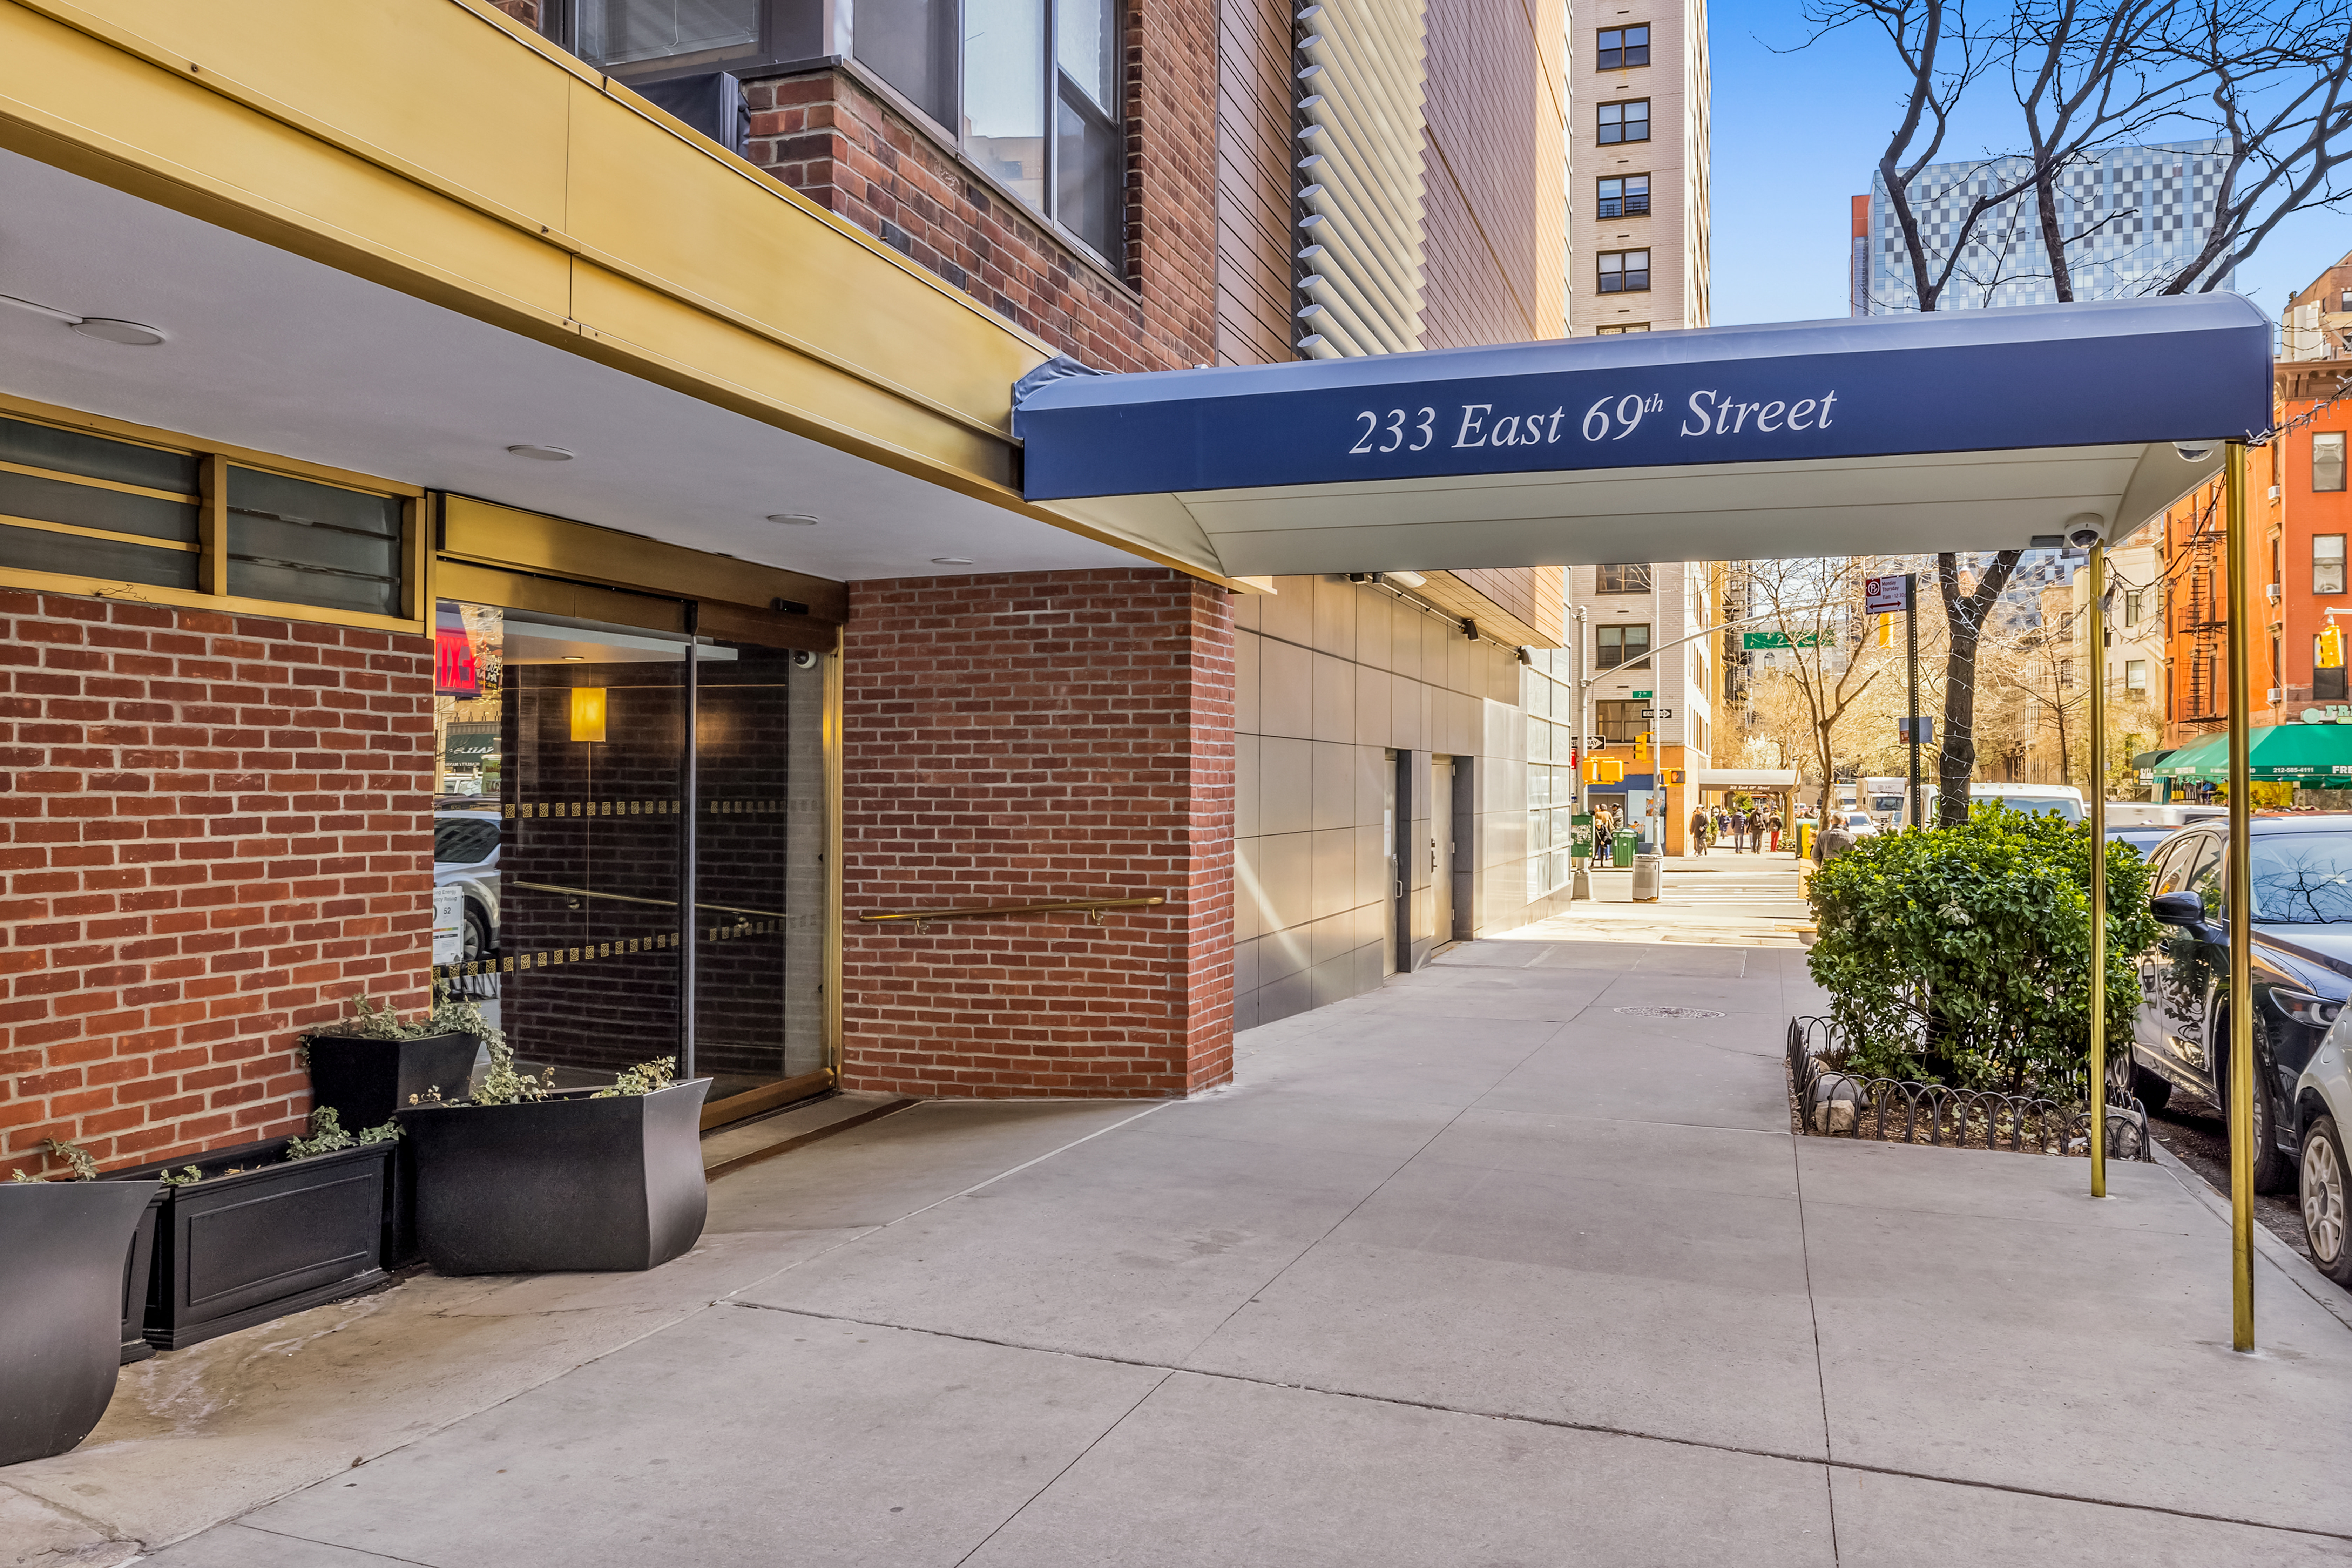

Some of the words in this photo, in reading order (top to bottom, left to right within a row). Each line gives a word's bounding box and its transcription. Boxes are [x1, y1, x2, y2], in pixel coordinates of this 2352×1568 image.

[1349, 407, 1435, 454] 233
[1451, 404, 1565, 448] East
[1582, 393, 1663, 441] 69th
[1680, 389, 1837, 437] Street
[1777, 635, 1784, 646] 2
